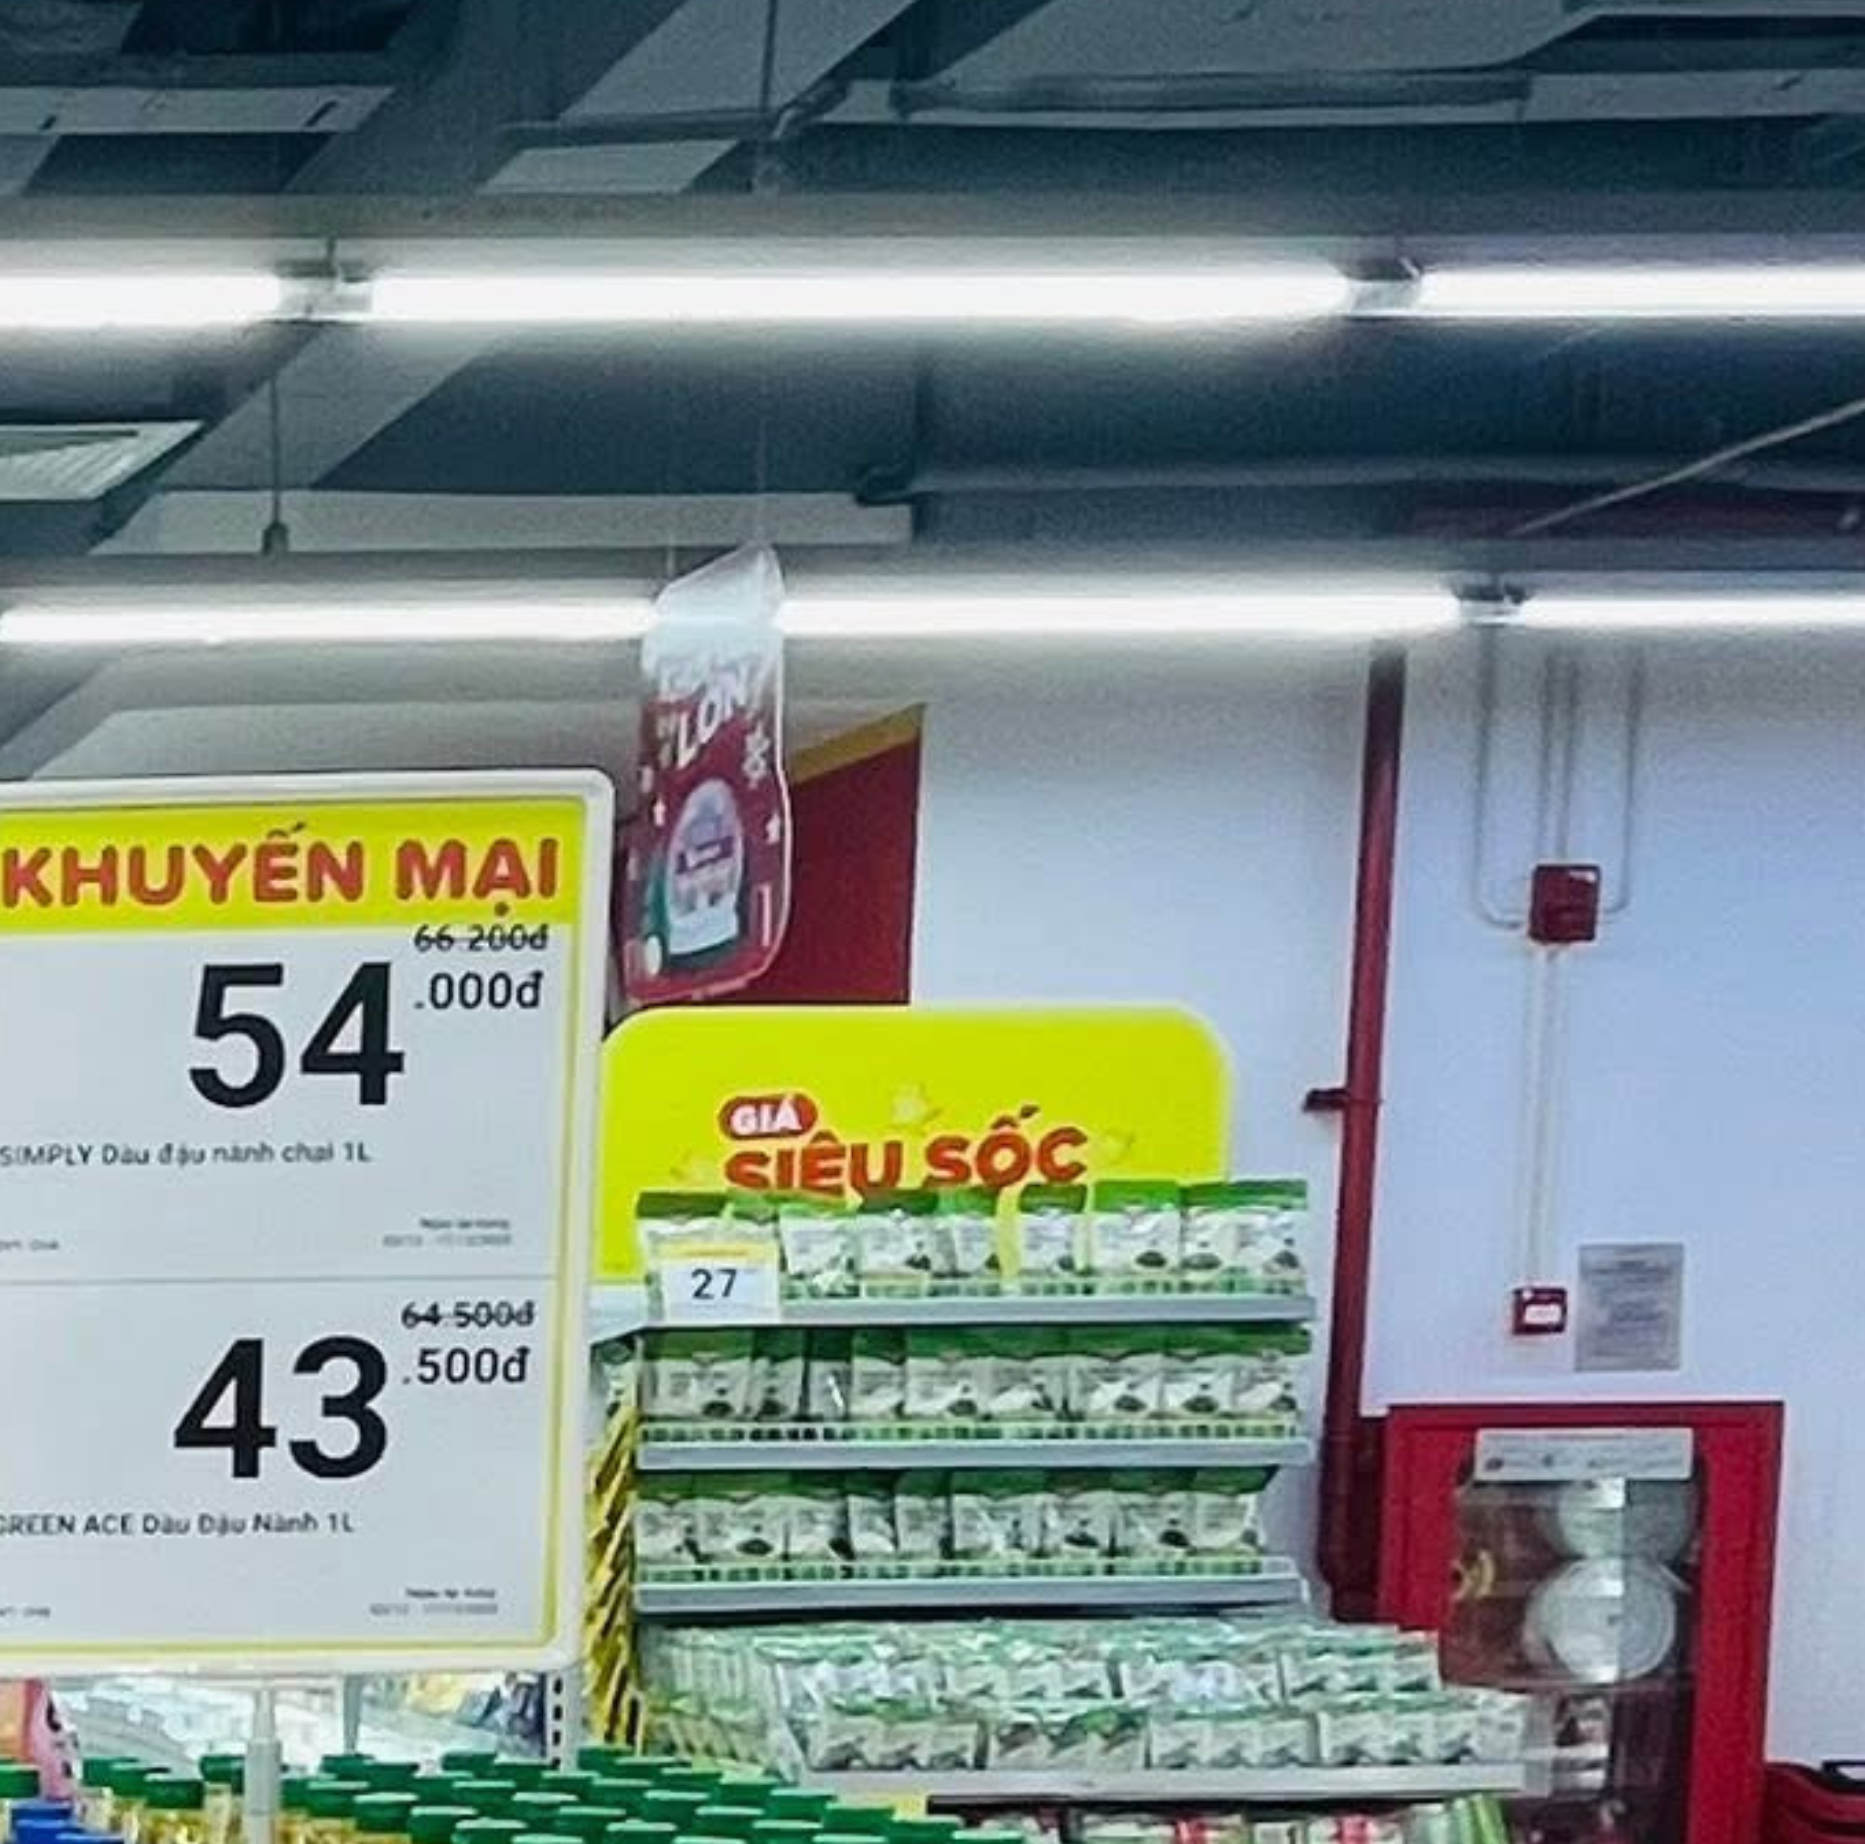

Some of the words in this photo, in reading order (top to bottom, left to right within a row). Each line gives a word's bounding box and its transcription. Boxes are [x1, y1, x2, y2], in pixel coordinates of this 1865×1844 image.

[2, 822, 363, 908] KHUYẾN
[396, 838, 558, 917] MẠI
[190, 962, 404, 1108] 54
[729, 1093, 804, 1136] GIÁ
[283, 1141, 334, 1164] chai
[344, 1141, 371, 1163] 1L
[924, 1105, 1089, 1190] SỐC
[691, 1268, 738, 1300] 27
[173, 1335, 387, 1478] 43
[83, 1512, 133, 1535] ACE
[328, 1512, 354, 1533] 1L
